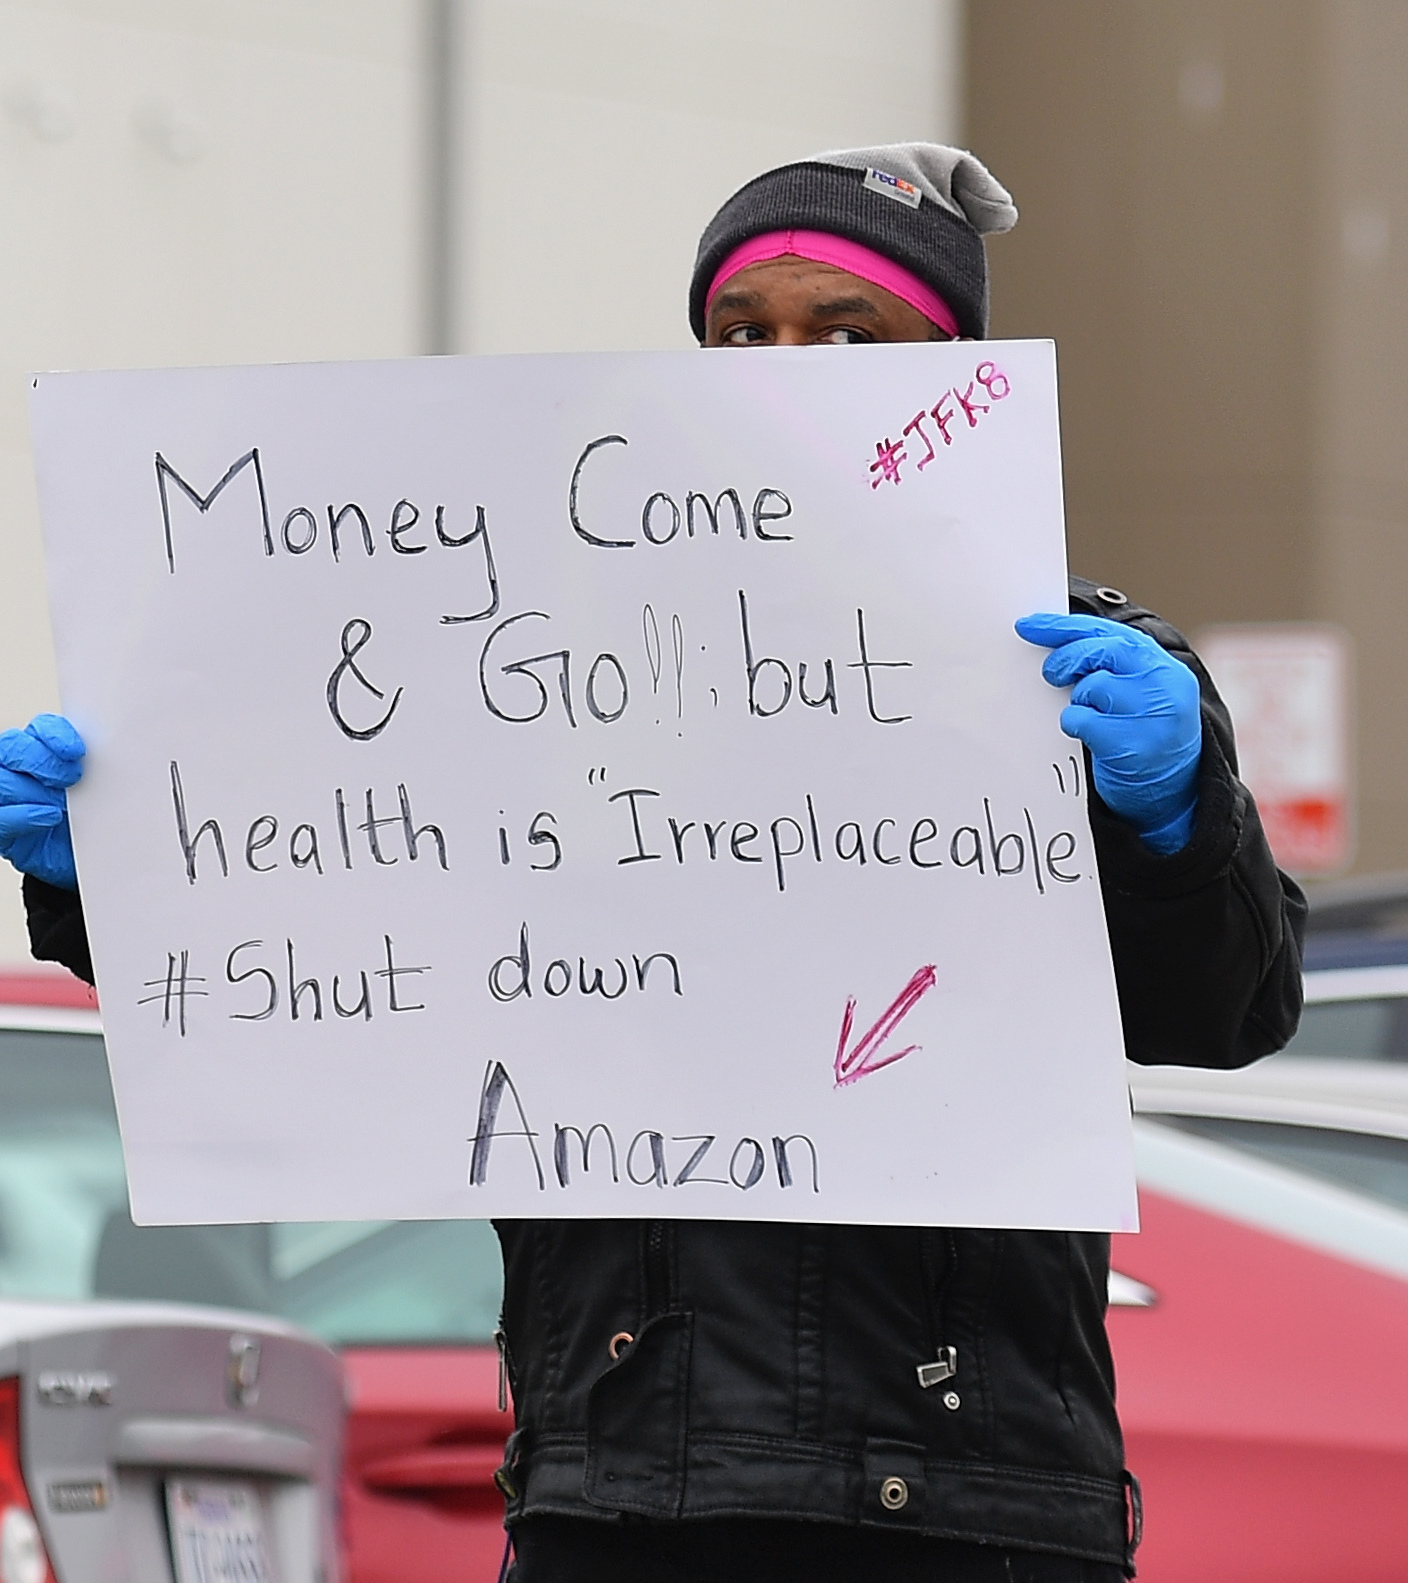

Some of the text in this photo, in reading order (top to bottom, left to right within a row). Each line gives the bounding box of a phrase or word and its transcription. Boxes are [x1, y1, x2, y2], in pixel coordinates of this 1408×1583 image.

[868, 360, 1012, 491] #JFK8
[155, 434, 795, 625] Money Come
[327, 618, 404, 741] &
[738, 589, 914, 724] but
[170, 760, 451, 886] health
[498, 809, 562, 871] is
[136, 920, 684, 1038] #Shut down
[466, 1059, 820, 1194] Amazon
